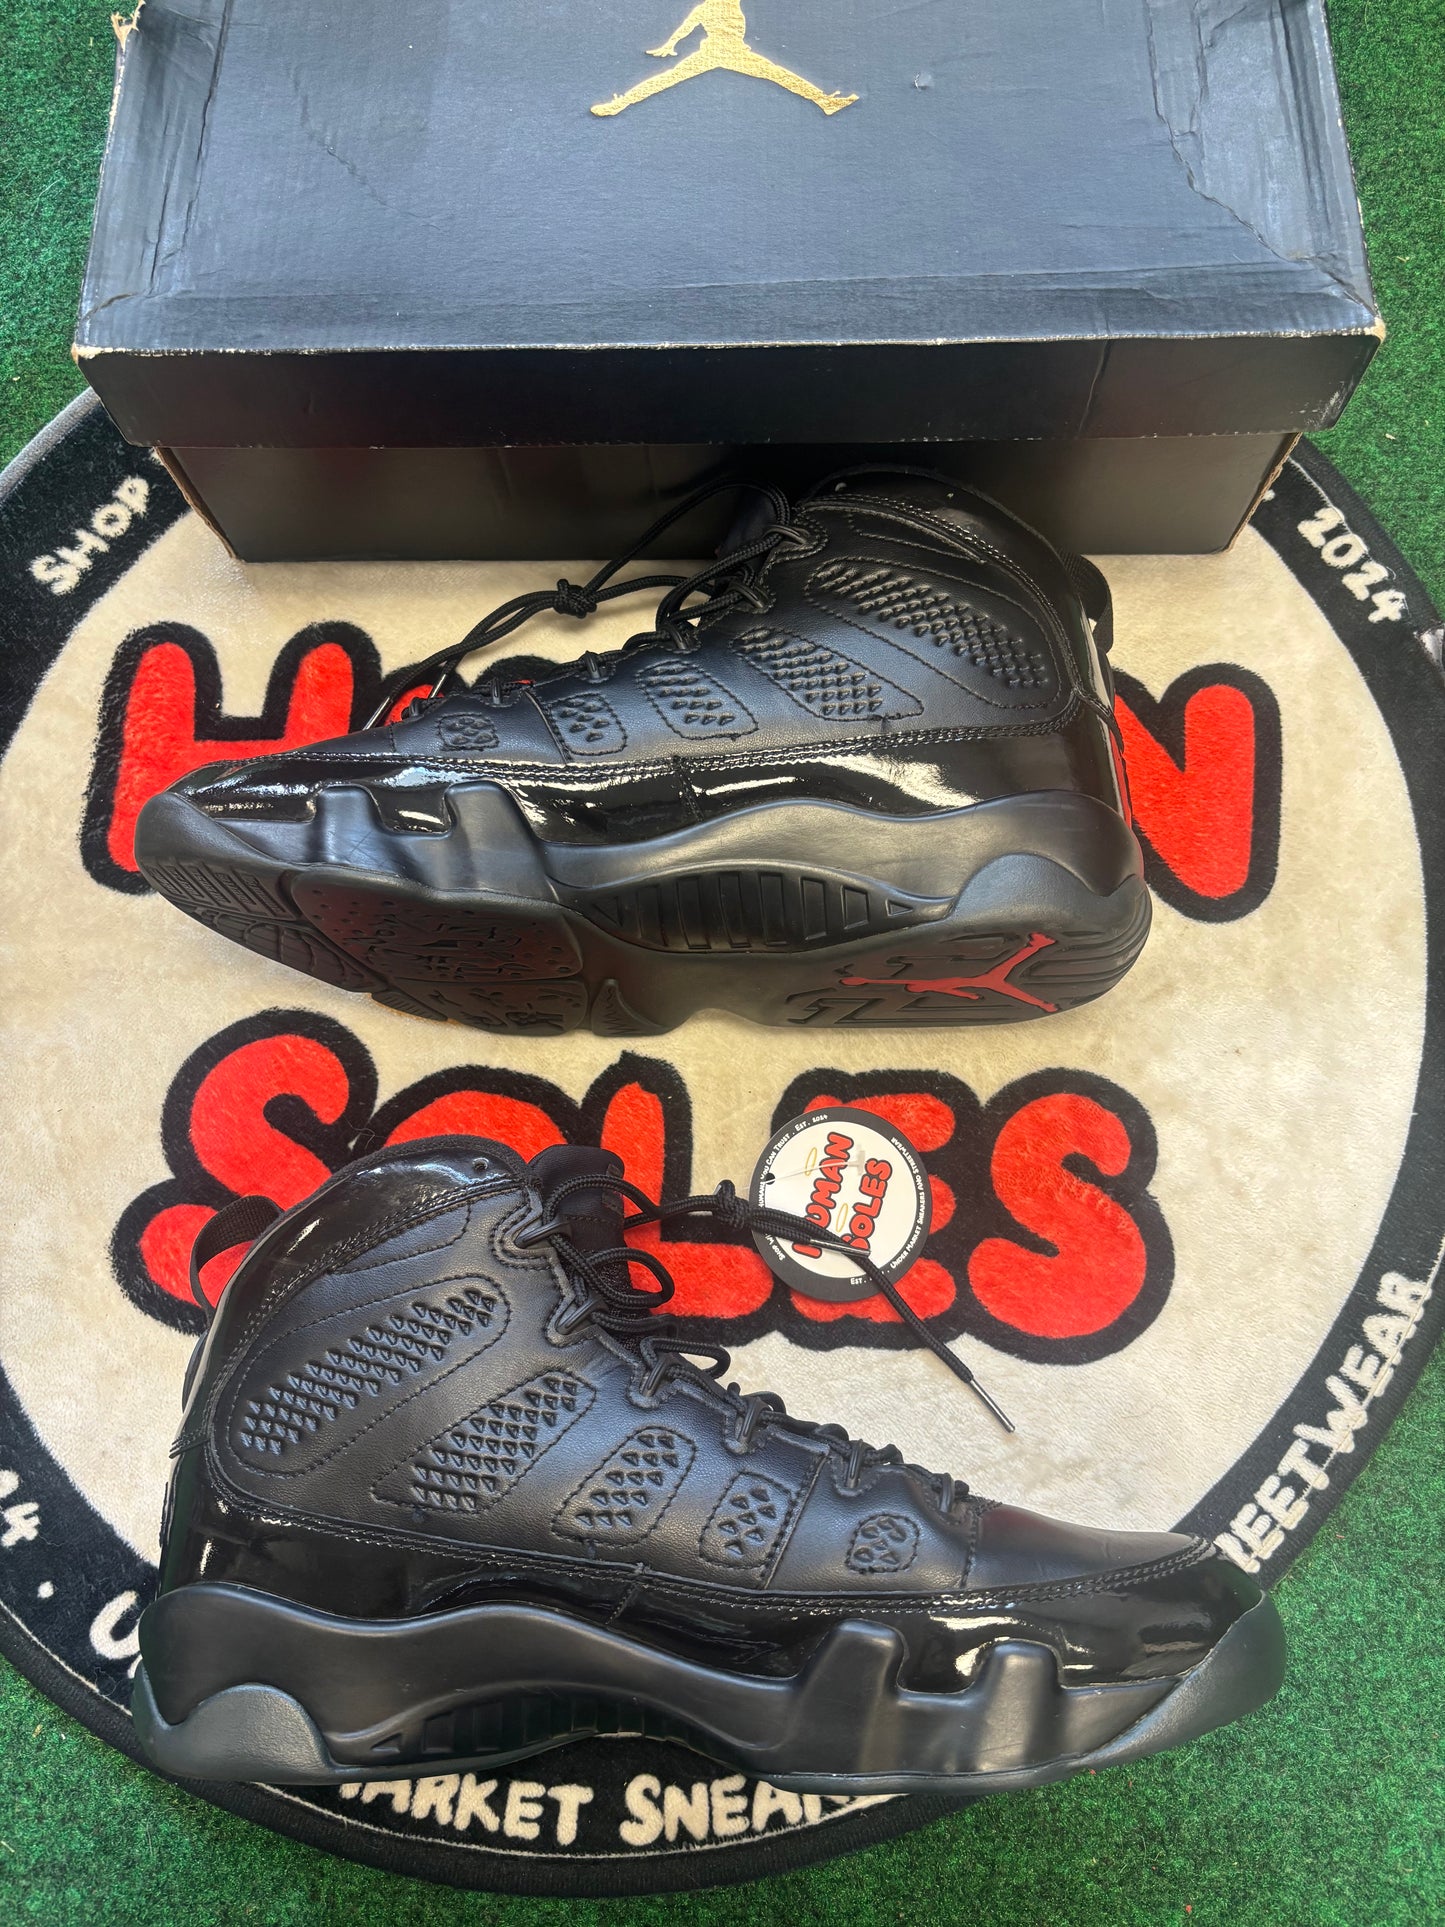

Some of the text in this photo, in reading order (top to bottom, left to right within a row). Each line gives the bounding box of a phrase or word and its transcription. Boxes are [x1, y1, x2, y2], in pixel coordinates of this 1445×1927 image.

[28, 474, 149, 596] SHOP
[1297, 507, 1407, 623] 2024
[812, 1114, 828, 1123] 2024
[773, 1133, 790, 1151] TRUST
[890, 1136, 920, 1174] STREETWEAR
[766, 1151, 777, 1165] CAN
[792, 1131, 855, 1259] UMAN
[915, 1174, 924, 1191] AND
[916, 1192, 926, 1225] SNEAKERS
[772, 1244, 786, 1260] SHOP
[905, 1225, 922, 1252] MARKET
[889, 1250, 909, 1269] UNDER
[339, 1773, 575, 1846] ARKET
